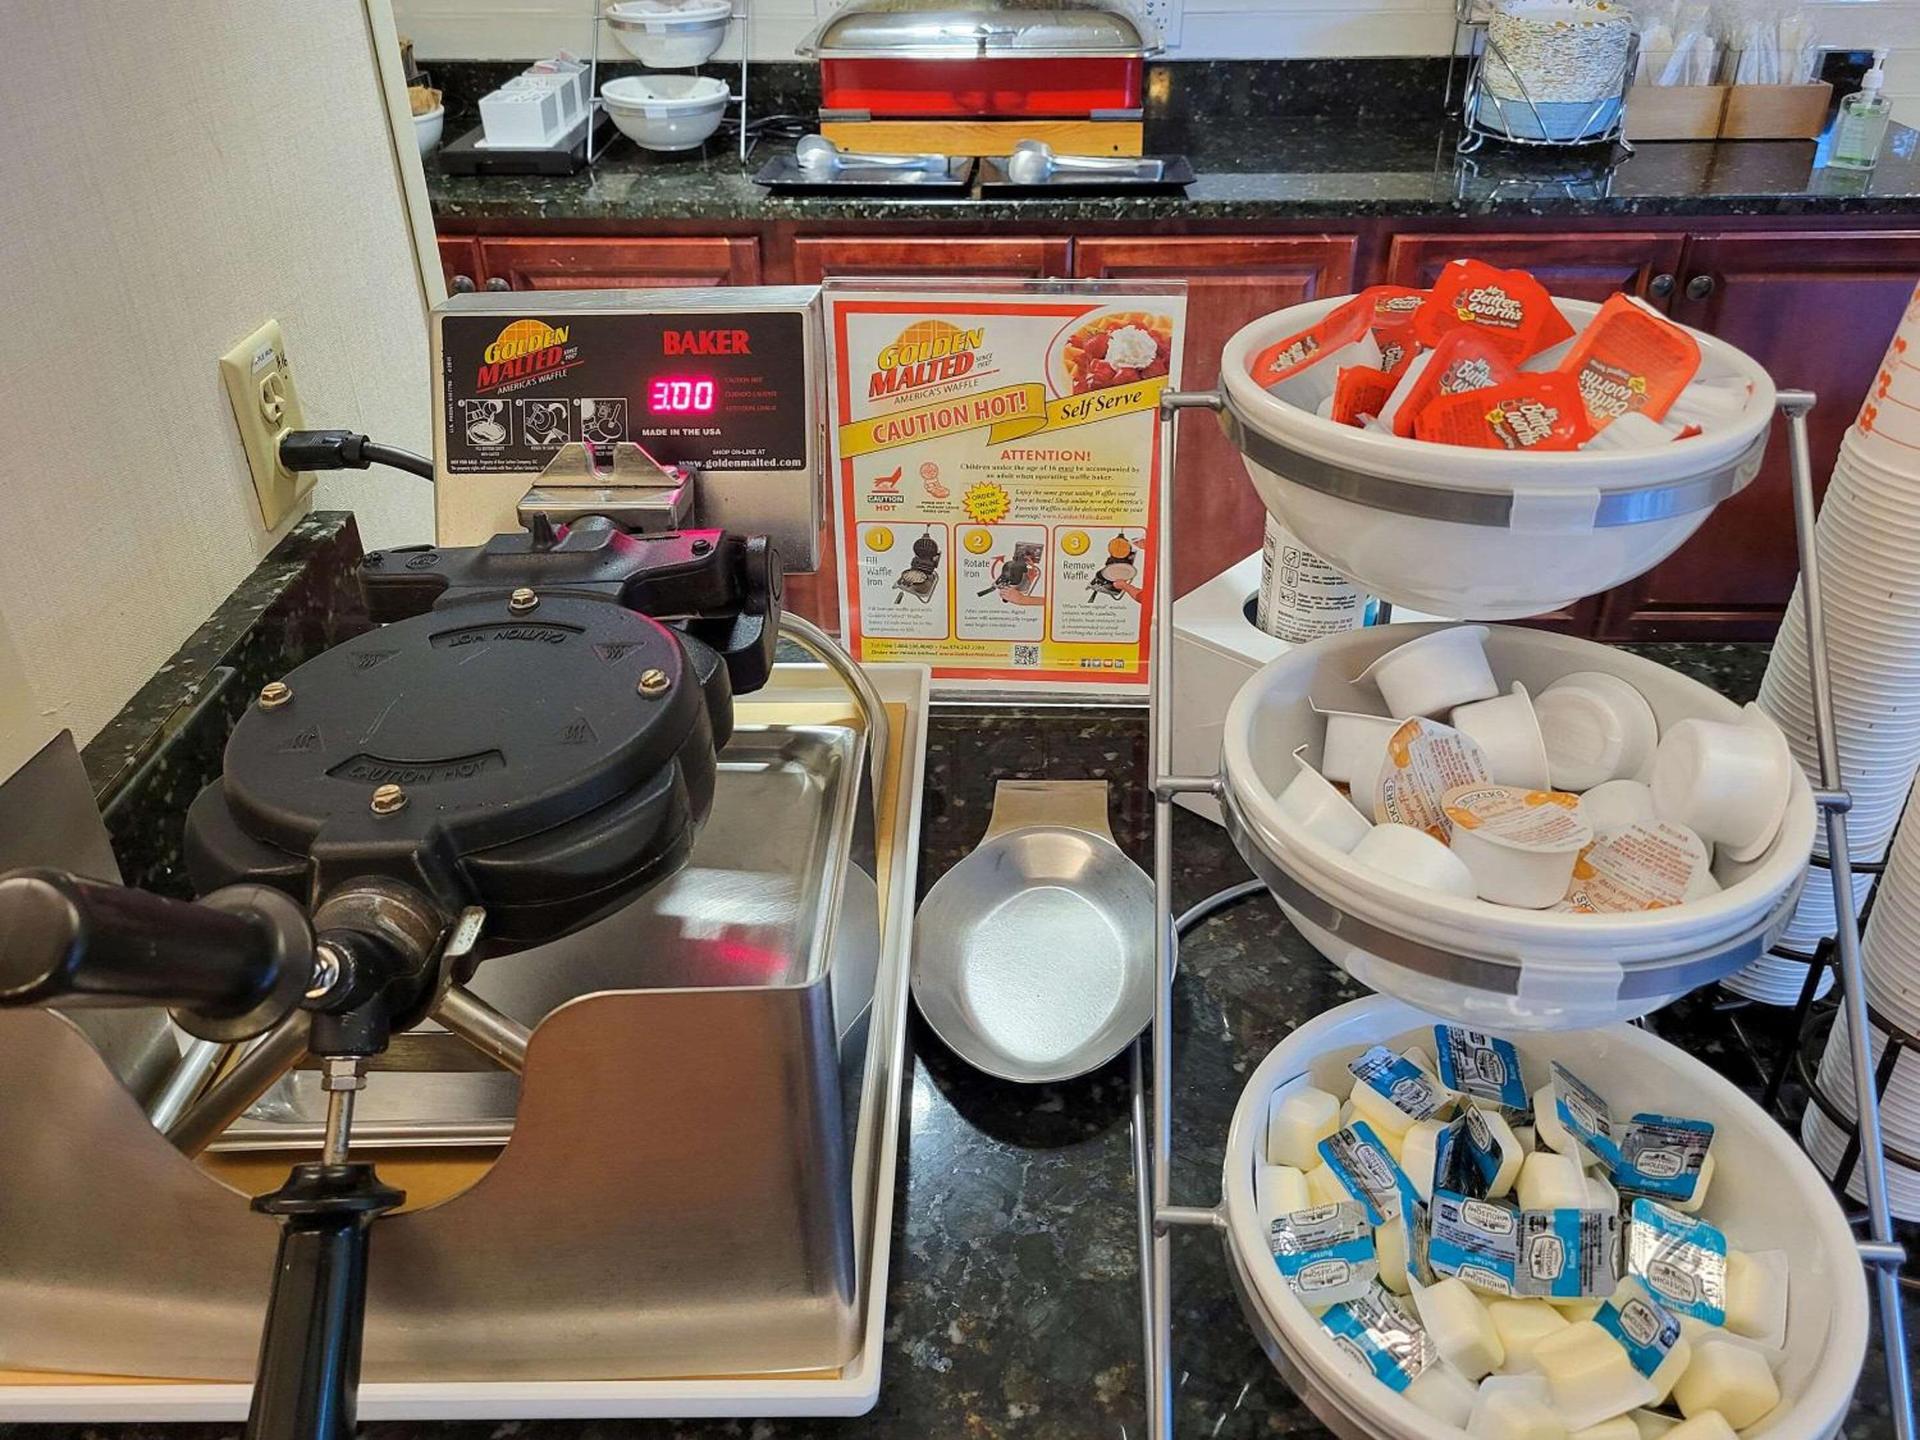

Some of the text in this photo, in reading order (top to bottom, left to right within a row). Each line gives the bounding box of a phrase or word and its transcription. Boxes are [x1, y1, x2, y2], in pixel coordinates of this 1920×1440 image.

[1468, 302, 1523, 320] worth's
[484, 325, 570, 365] GOLDEN
[663, 329, 752, 355] BAKER
[878, 327, 985, 370] GOLDEN
[476, 346, 565, 388] MALTED
[869, 351, 975, 397] MALTED
[497, 369, 568, 396] AMERICA'S WAFFLE
[894, 379, 979, 404] AMERICA'S WAFFLE
[1061, 391, 1142, 420] Self Serve
[873, 391, 1027, 443] CAUTION HOT!
[642, 428, 721, 436] MADE IN THE USA
[1001, 449, 1091, 461] ATTENTION!
[679, 457, 802, 469] www.goldenmalted.com
[1086, 465, 1130, 473] accompanied
[868, 495, 904, 503] CAUTION
[972, 492, 996, 501] ORDER
[974, 499, 1001, 509] ONLINE
[865, 556, 878, 564] Fill
[963, 558, 990, 568] Rotate
[1063, 560, 1096, 570] Remove
[866, 567, 893, 577] Waffle
[963, 569, 980, 578] Iron
[1063, 571, 1090, 580] Waffle
[866, 578, 883, 586] Iron
[493, 629, 568, 644] CAUTION
[350, 765, 433, 783] CAUTION
